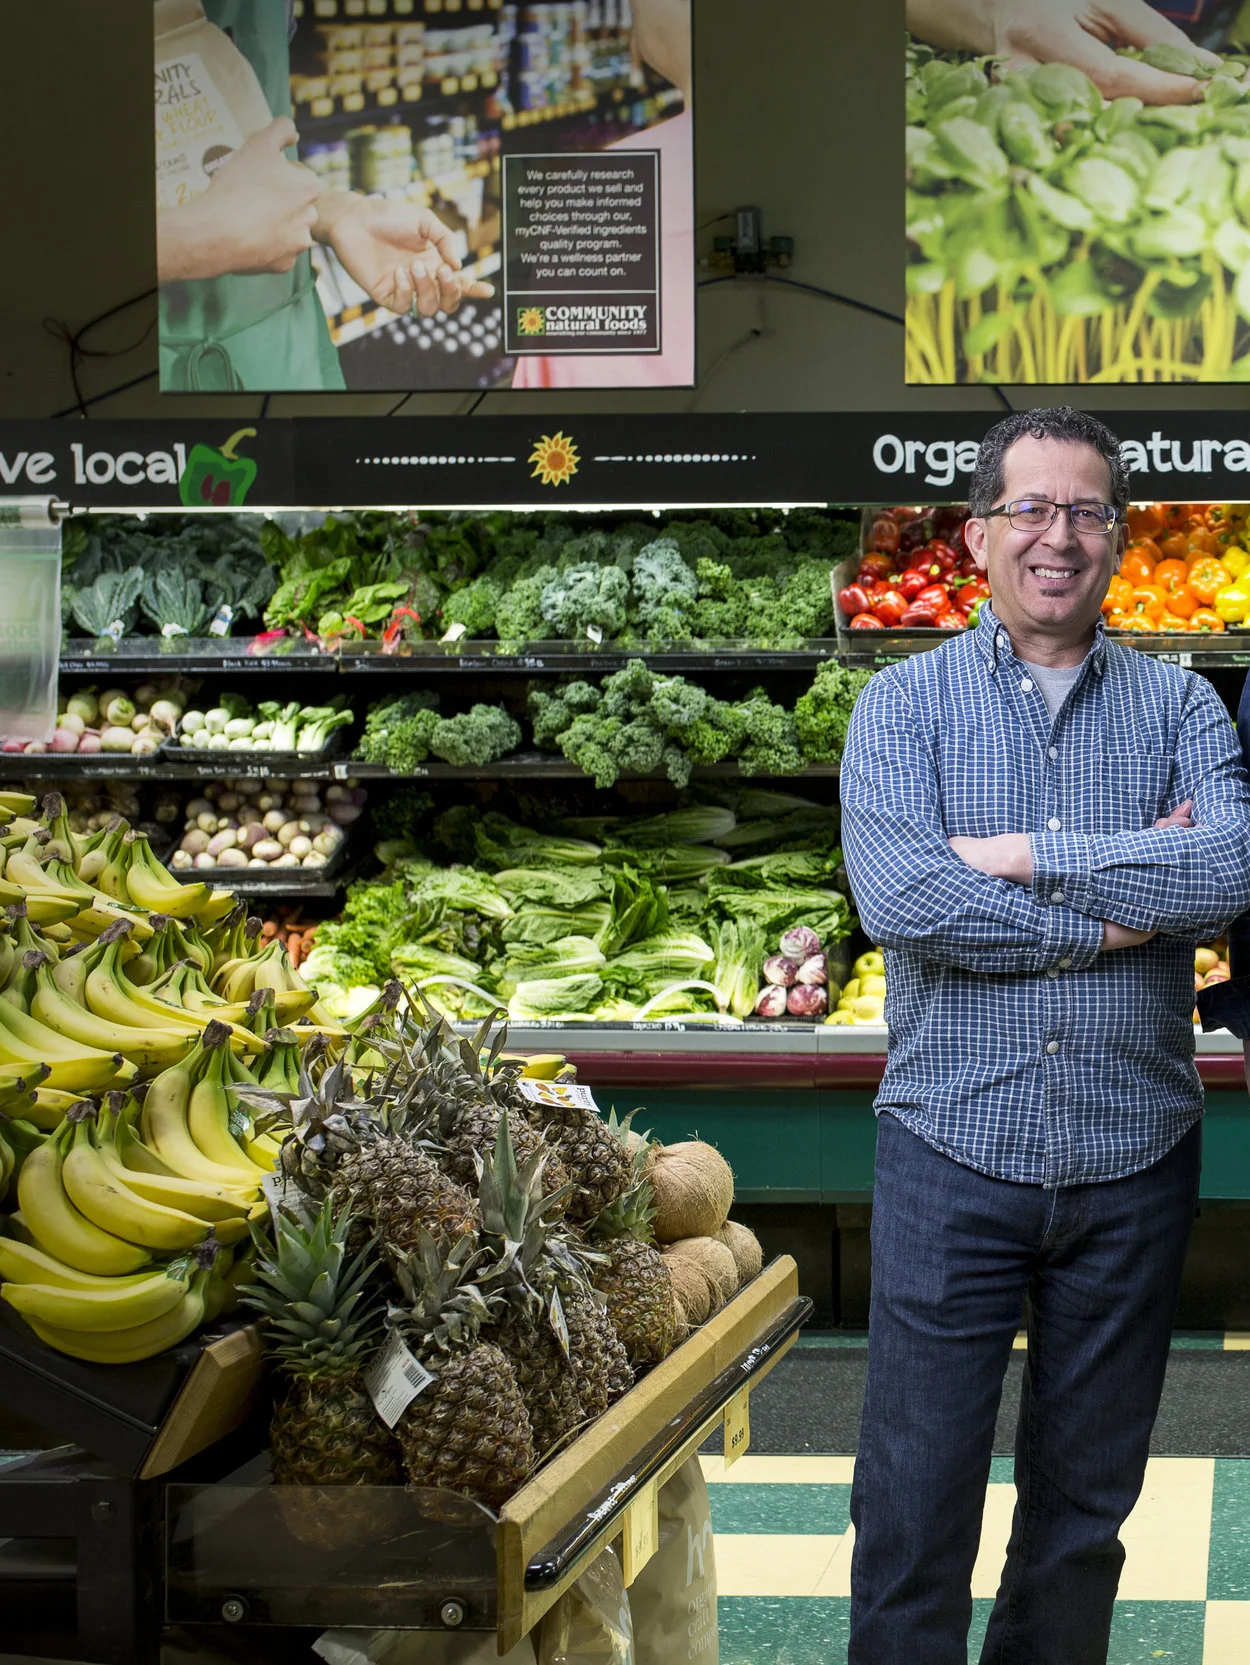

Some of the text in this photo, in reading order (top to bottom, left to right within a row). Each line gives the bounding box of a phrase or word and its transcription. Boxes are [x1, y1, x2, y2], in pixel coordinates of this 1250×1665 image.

[527, 169, 634, 182] We carefully research
[518, 183, 643, 195] every product we sell and
[520, 198, 641, 209] help you make informed
[529, 212, 632, 222] choices through our,
[516, 225, 647, 237] myCNF-Verified ingredients
[540, 240, 622, 250] quality program.
[521, 253, 549, 263] We're
[561, 253, 603, 262] wellness
[606, 253, 641, 263] partner
[536, 267, 626, 279] you can count on.
[545, 306, 647, 319] COMMUNITY
[546, 318, 647, 330] natural foods
[70, 443, 186, 485] local
[873, 434, 977, 486] Orga
